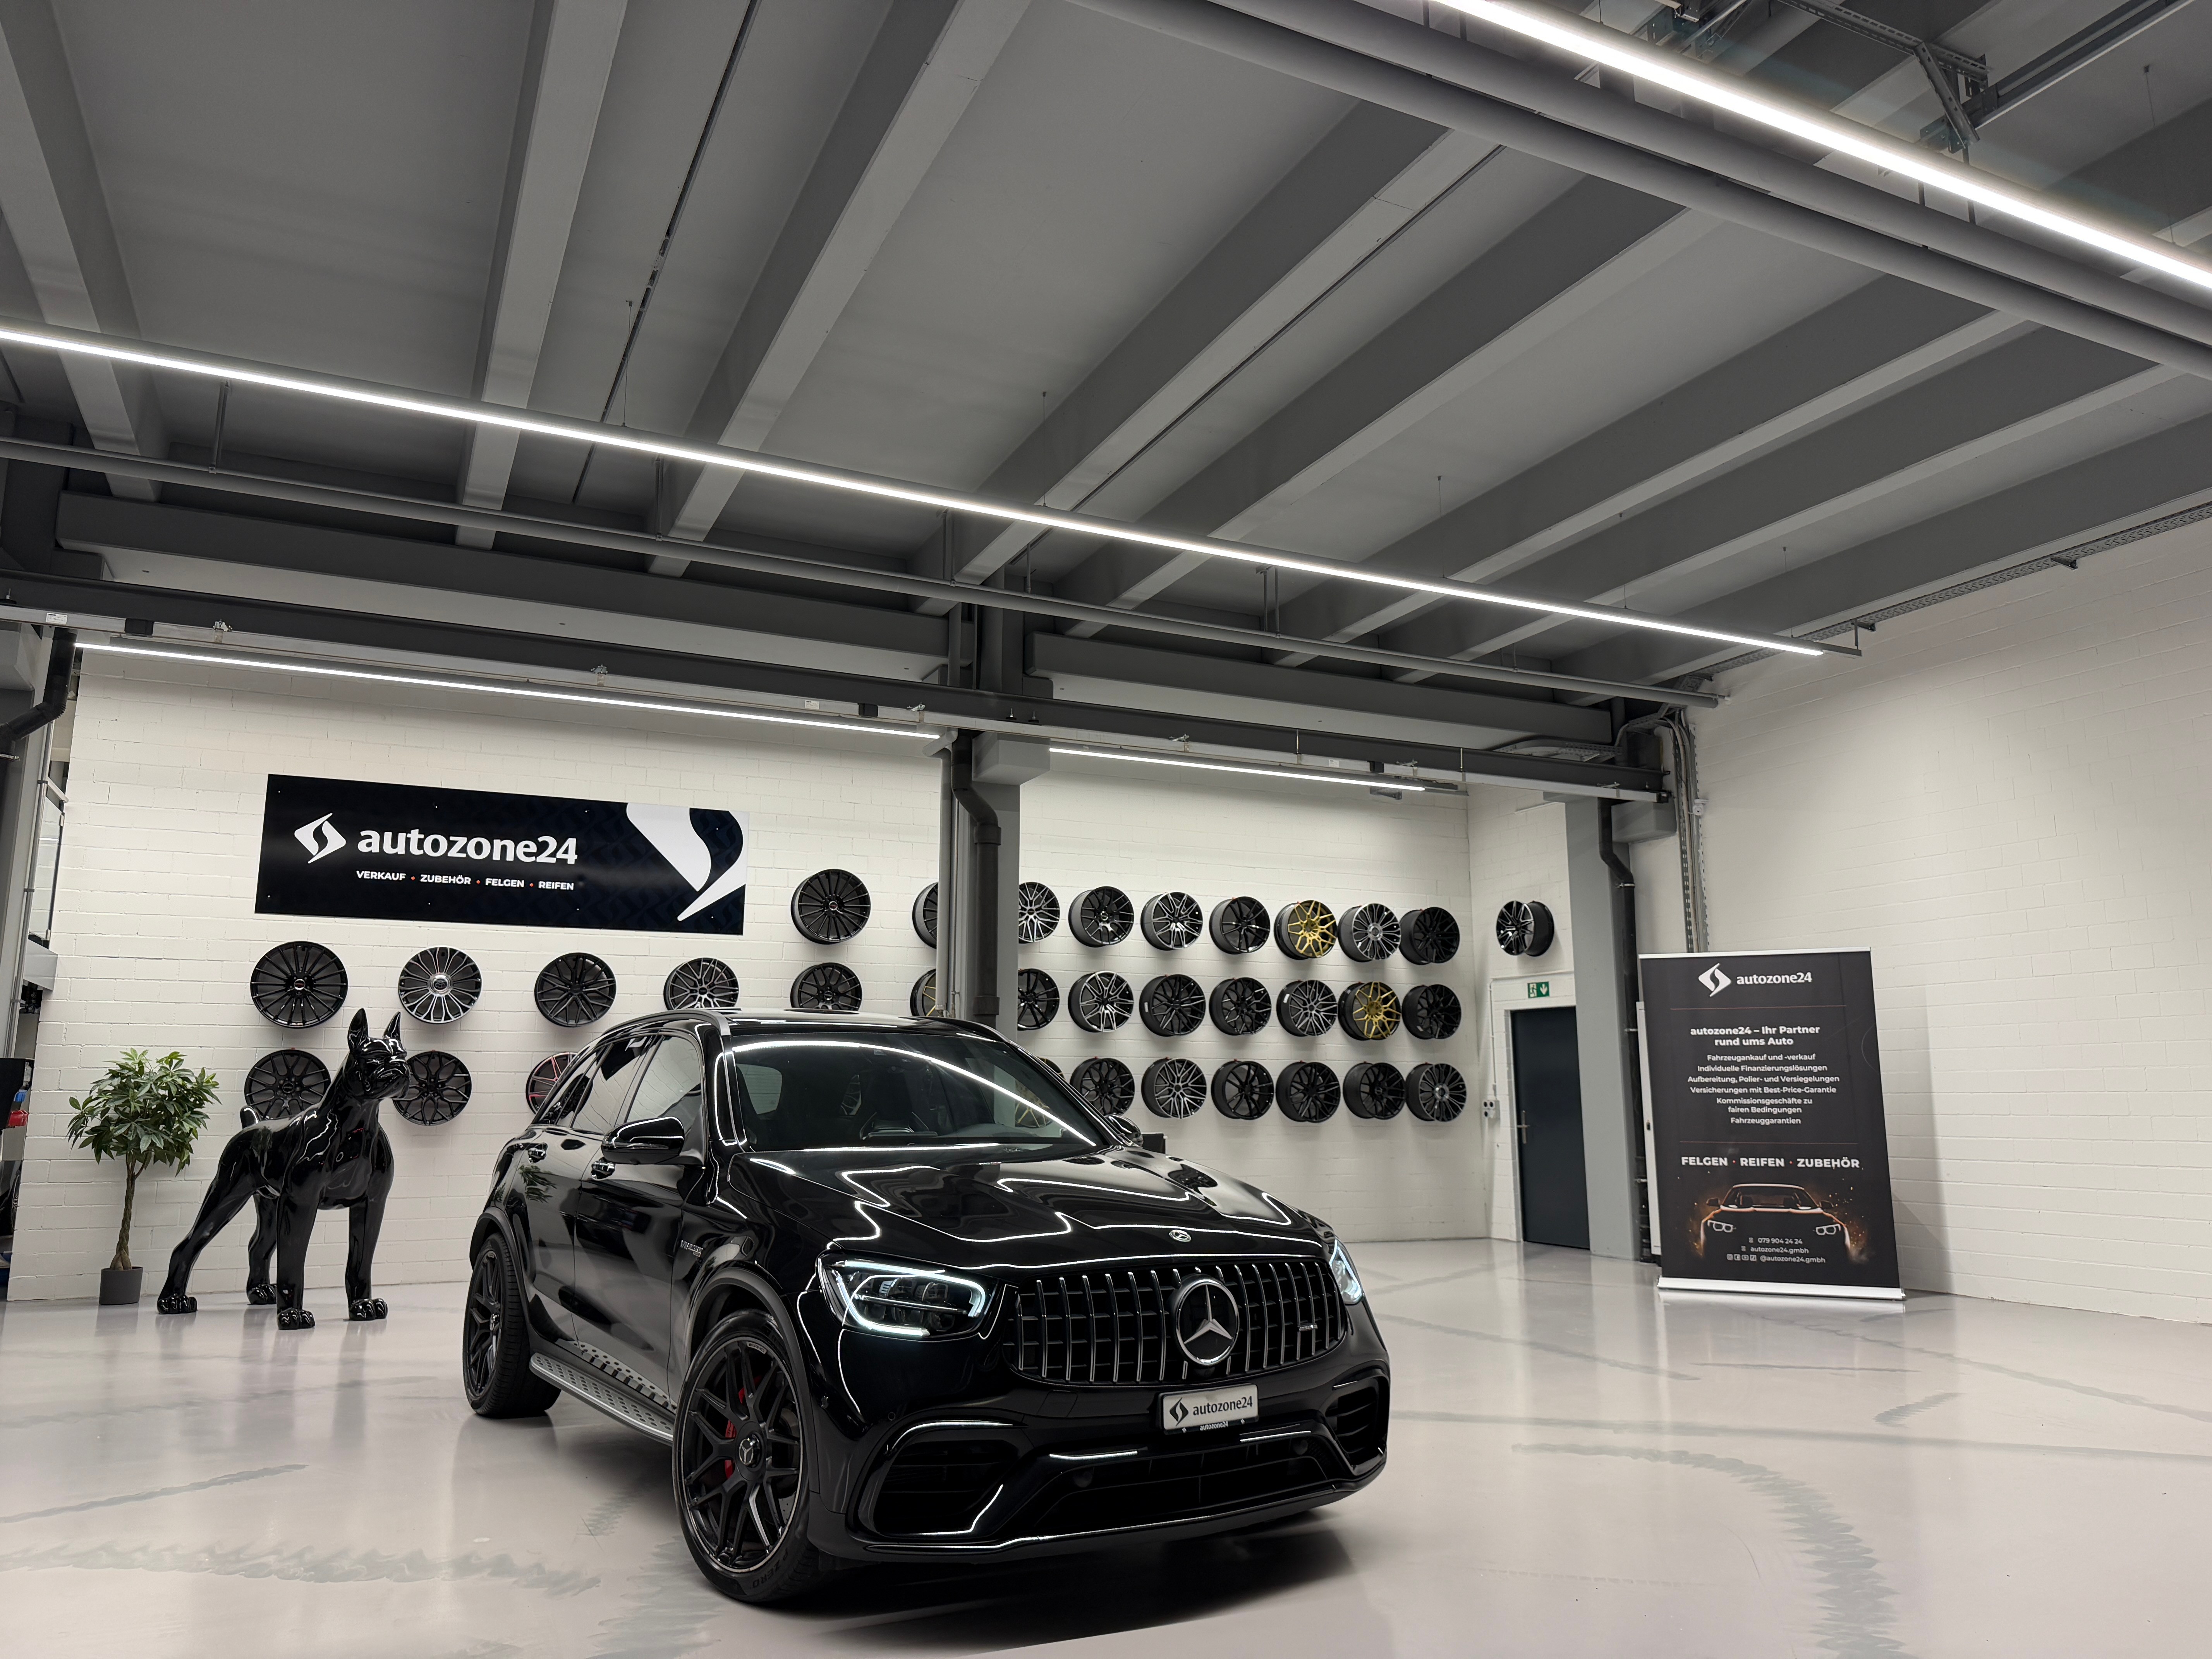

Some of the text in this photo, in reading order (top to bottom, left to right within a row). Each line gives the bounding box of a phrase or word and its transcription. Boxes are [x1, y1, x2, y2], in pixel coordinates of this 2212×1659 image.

[357, 829, 578, 864] autozone24
[356, 870, 574, 890] VERKAUF ZUBEHÖR FELGEN REIFEN
[1736, 972, 1812, 985] autozone24
[1690, 1027, 1752, 1035] autozone24
[1762, 1026, 1777, 1034] Ihr
[1779, 1026, 1820, 1034] Partner
[1714, 1037, 1740, 1046] rund
[1767, 1037, 1794, 1045] Auto
[1707, 1054, 1767, 1062] Fahrzeugankauf
[1741, 1065, 1827, 1073] Finanzierungslösungen
[1687, 1076, 1738, 1084] Aufbereitung,
[1780, 1075, 1840, 1084] Versiegelungen
[1690, 1086, 1748, 1094] Versicherungen
[1716, 1097, 1802, 1105] Kommissionsgeschäfte
[1751, 1106, 1802, 1115] Bedingungen
[1730, 1117, 1801, 1125] Fahrzeuggarantien
[1681, 1156, 1860, 1168] FELGEN REIFEN ZUBEHÖR
[1760, 1255, 1826, 1264] @autozone24.gmbh
[1193, 1396, 1253, 1416] autozone24
[1200, 1420, 1228, 1431] autozone24
